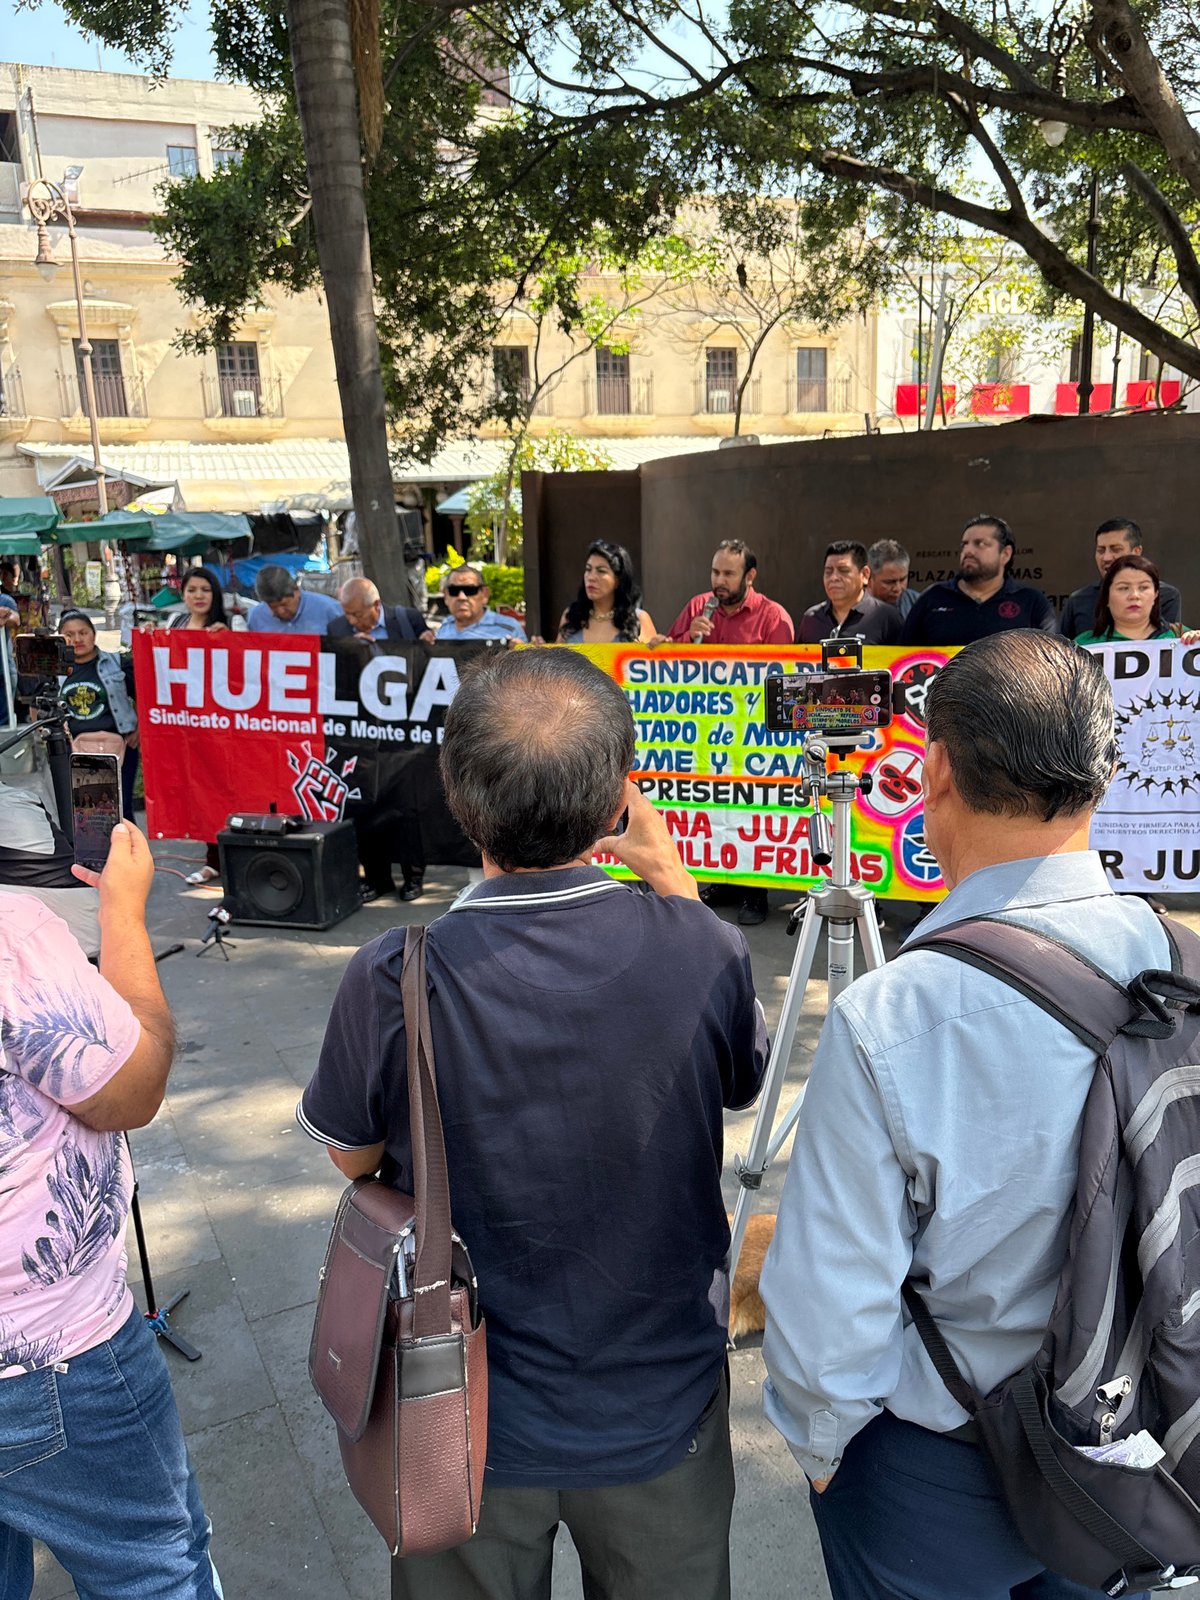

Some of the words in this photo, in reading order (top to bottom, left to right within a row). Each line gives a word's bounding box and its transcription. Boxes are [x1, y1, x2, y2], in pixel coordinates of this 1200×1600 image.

[908, 570, 956, 582] PLAZA
[153, 646, 462, 722] HUELGA
[149, 707, 231, 729] Sindicato
[235, 714, 317, 735] Nacional
[322, 721, 347, 737] de
[351, 720, 406, 741] Monte
[410, 725, 433, 744] de
[707, 722, 734, 746] de
